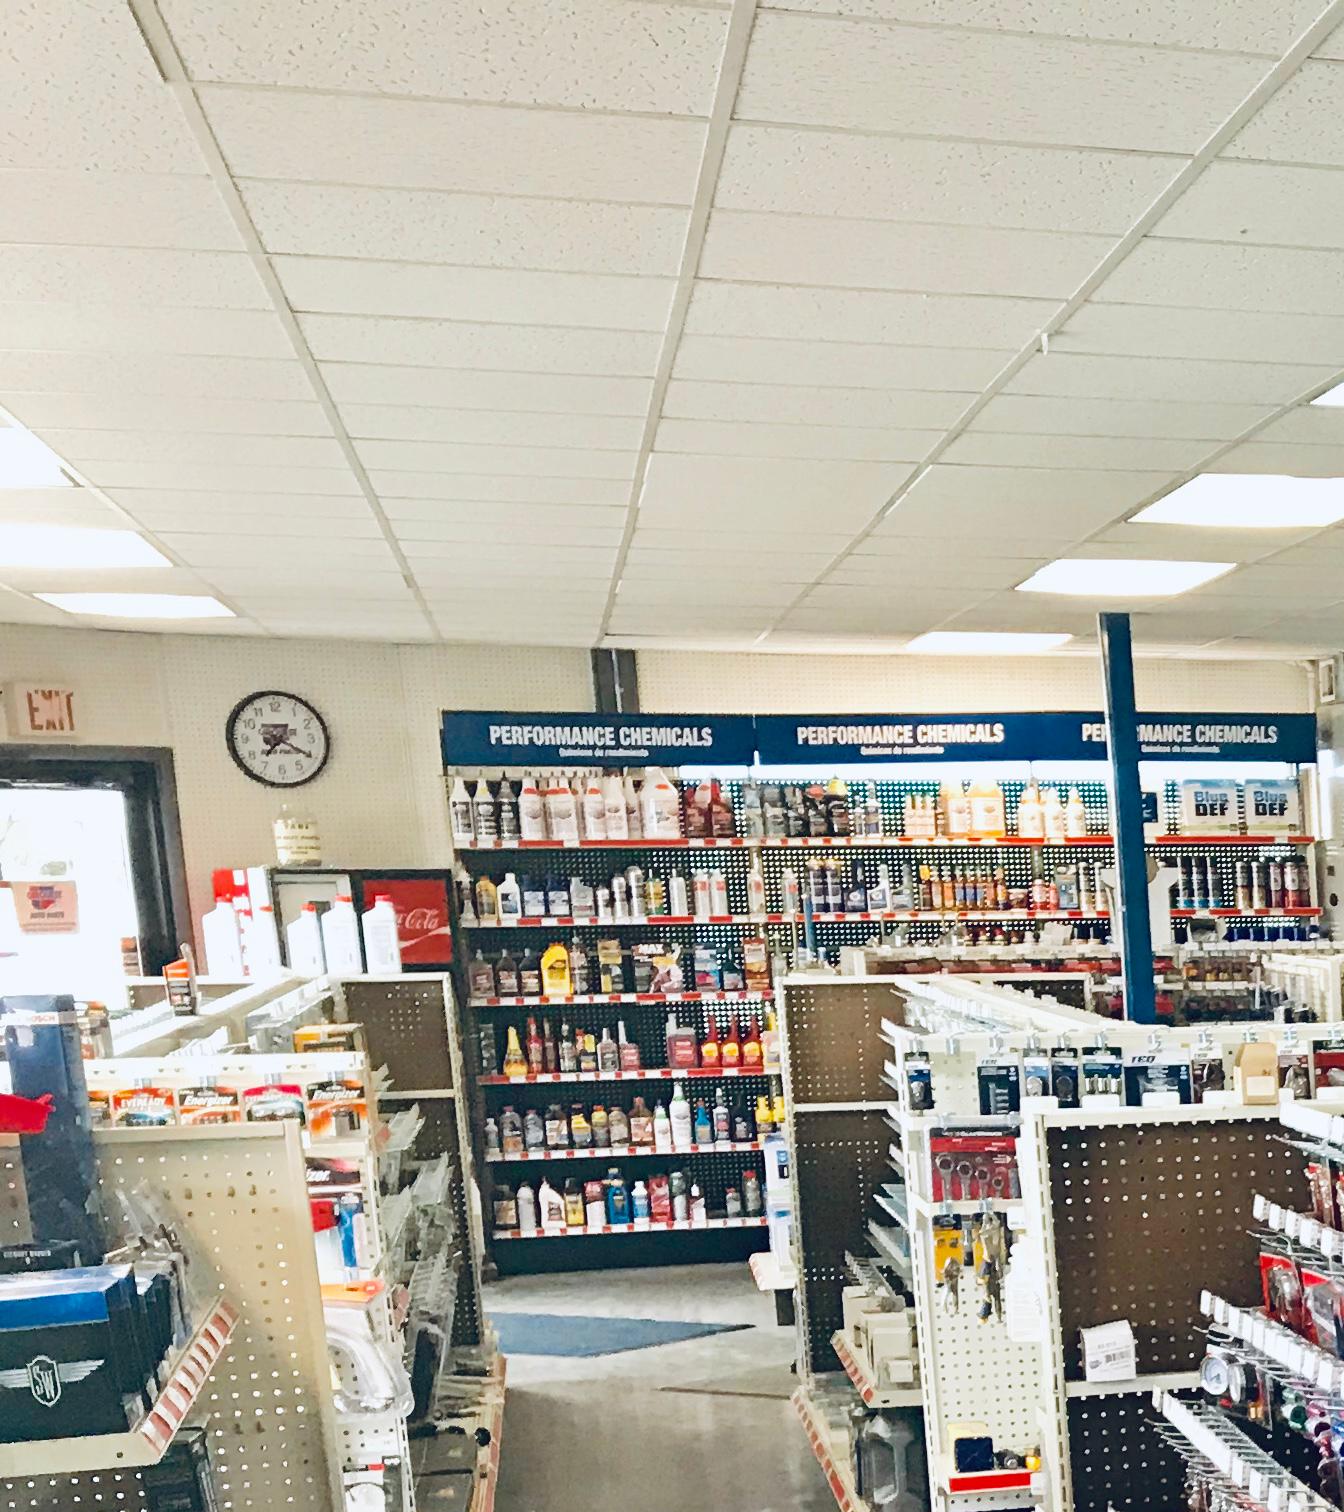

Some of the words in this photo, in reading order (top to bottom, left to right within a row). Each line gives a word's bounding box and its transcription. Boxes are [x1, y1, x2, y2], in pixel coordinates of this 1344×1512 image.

[489, 725, 616, 747] PERFORMANCE
[619, 726, 713, 747] CHEMICALS
[797, 725, 914, 746] PERFORMANCE
[916, 723, 1005, 744] CHEMICALS
[1195, 725, 1278, 745] CHEMICALS
[1194, 790, 1229, 804] Blue
[1253, 790, 1288, 804] Blue
[1195, 803, 1229, 817] DEF
[1254, 803, 1288, 817] DEF
[183, 1093, 232, 1107] Energizer
[313, 1088, 361, 1102] Energizer
